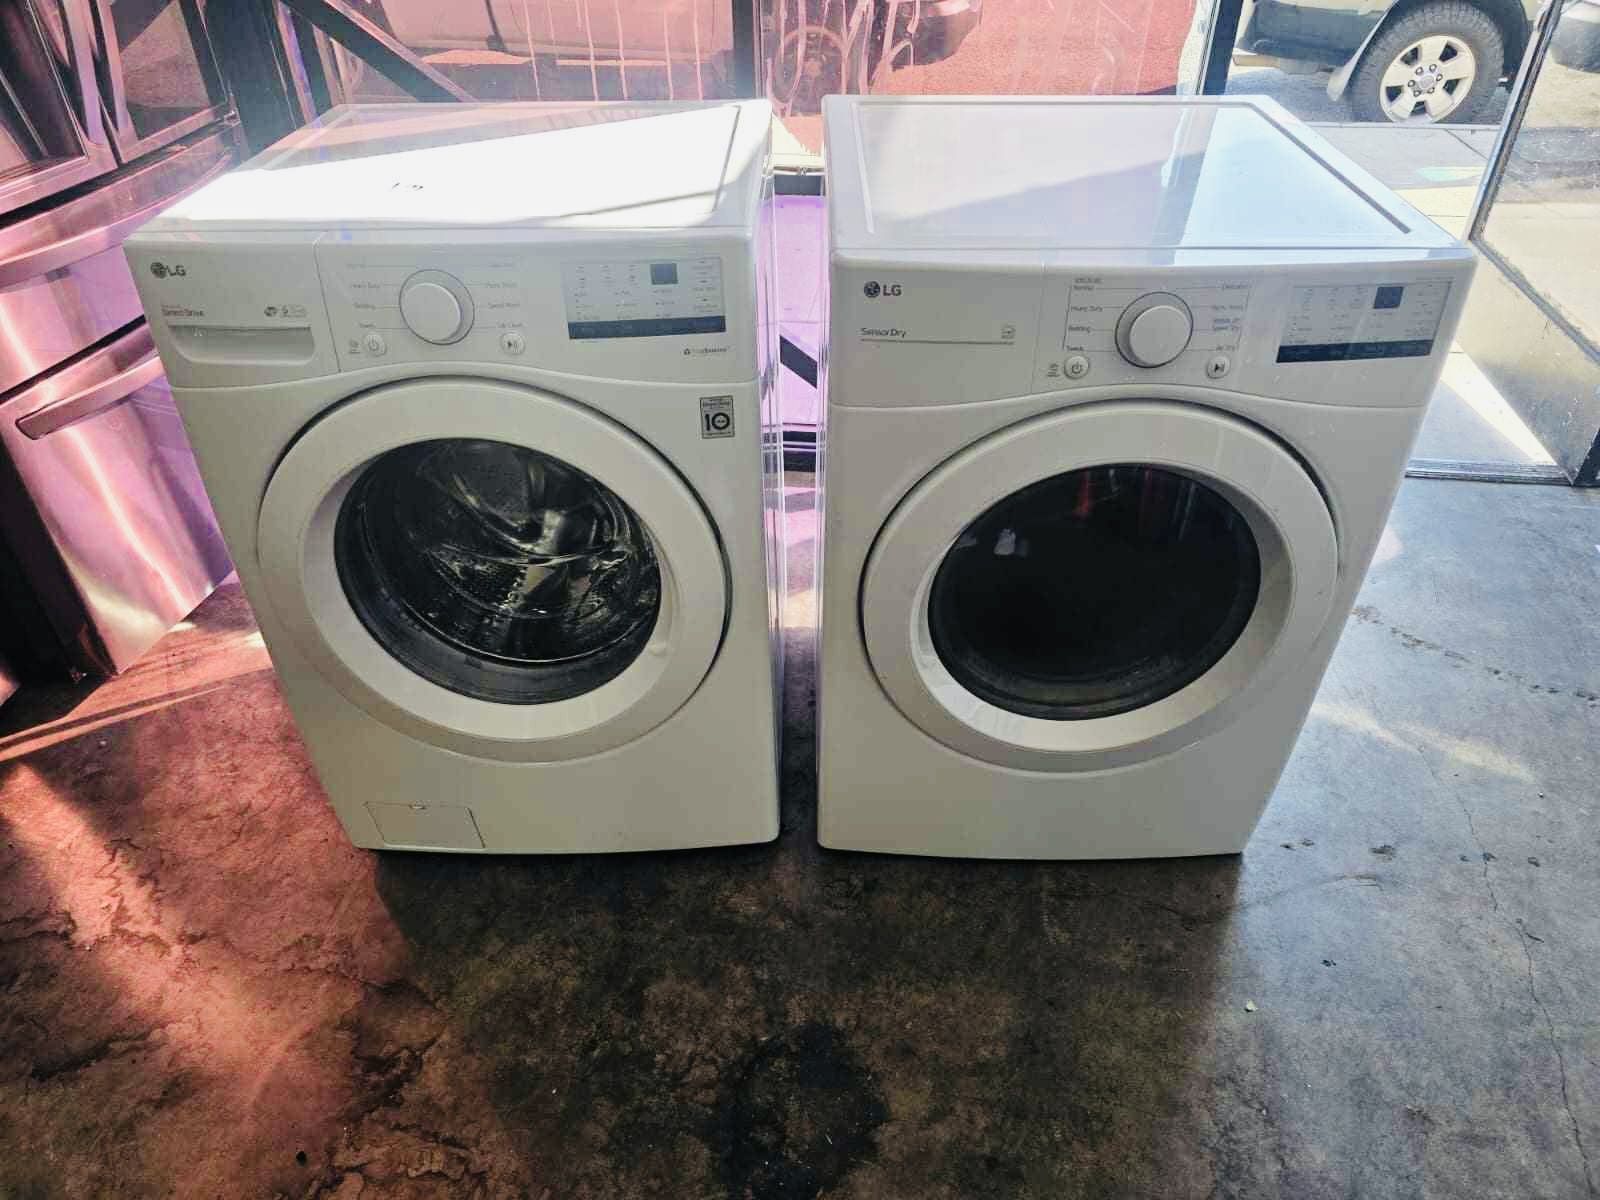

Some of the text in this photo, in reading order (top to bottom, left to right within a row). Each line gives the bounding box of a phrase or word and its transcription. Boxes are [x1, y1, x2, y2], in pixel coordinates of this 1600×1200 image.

[882, 284, 902, 297] LG
[860, 327, 907, 339] Sensor Dry
